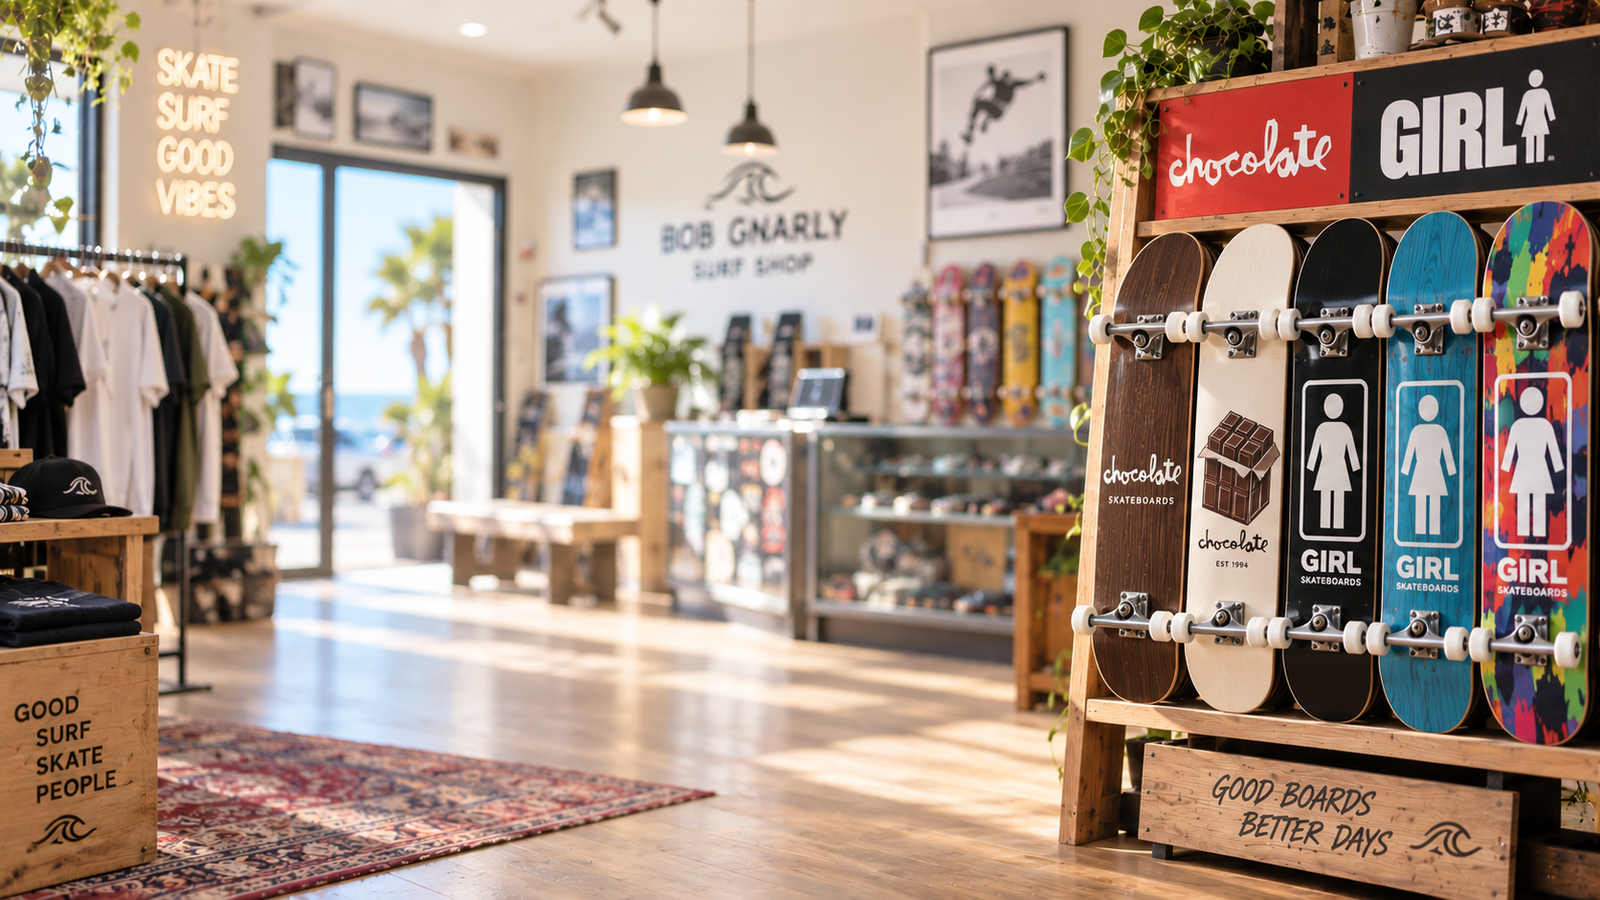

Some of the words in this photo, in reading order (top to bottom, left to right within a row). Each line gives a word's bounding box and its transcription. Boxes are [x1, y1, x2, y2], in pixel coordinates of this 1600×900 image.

[157, 48, 239, 94] SKATE
[156, 92, 230, 134] SURF
[1380, 87, 1518, 180] GIRL
[157, 136, 234, 176] GOOD
[1169, 118, 1332, 188] chocolate
[156, 178, 236, 220] VIBES
[661, 221, 714, 253] BOB
[728, 209, 848, 247] GNARLY
[694, 258, 743, 280] SURF
[756, 253, 814, 276] SHOP
[1103, 454, 1182, 486] chocolate
[1108, 495, 1174, 505] SKATEBOARDS
[1198, 529, 1268, 553] chocolate
[1215, 560, 1229, 568] EST
[1232, 561, 1248, 569] 1994
[1300, 549, 1362, 575] GIRL
[1396, 555, 1459, 581] GIRL
[1497, 557, 1567, 584] GIRL
[1300, 576, 1361, 586] SKATEBOARDS
[1396, 582, 1459, 593] SKATEBOARDS
[1497, 585, 1568, 598] SKATEBOARDS
[14, 695, 80, 723] GOOD
[35, 720, 92, 748] SURF
[36, 745, 103, 775] SKATE
[36, 769, 117, 804] PEOPLE
[1212, 774, 1275, 806] GOOD
[1280, 782, 1377, 816] BOARDS
[1238, 811, 1324, 846] BETTER
[1331, 824, 1393, 858] DAYS
